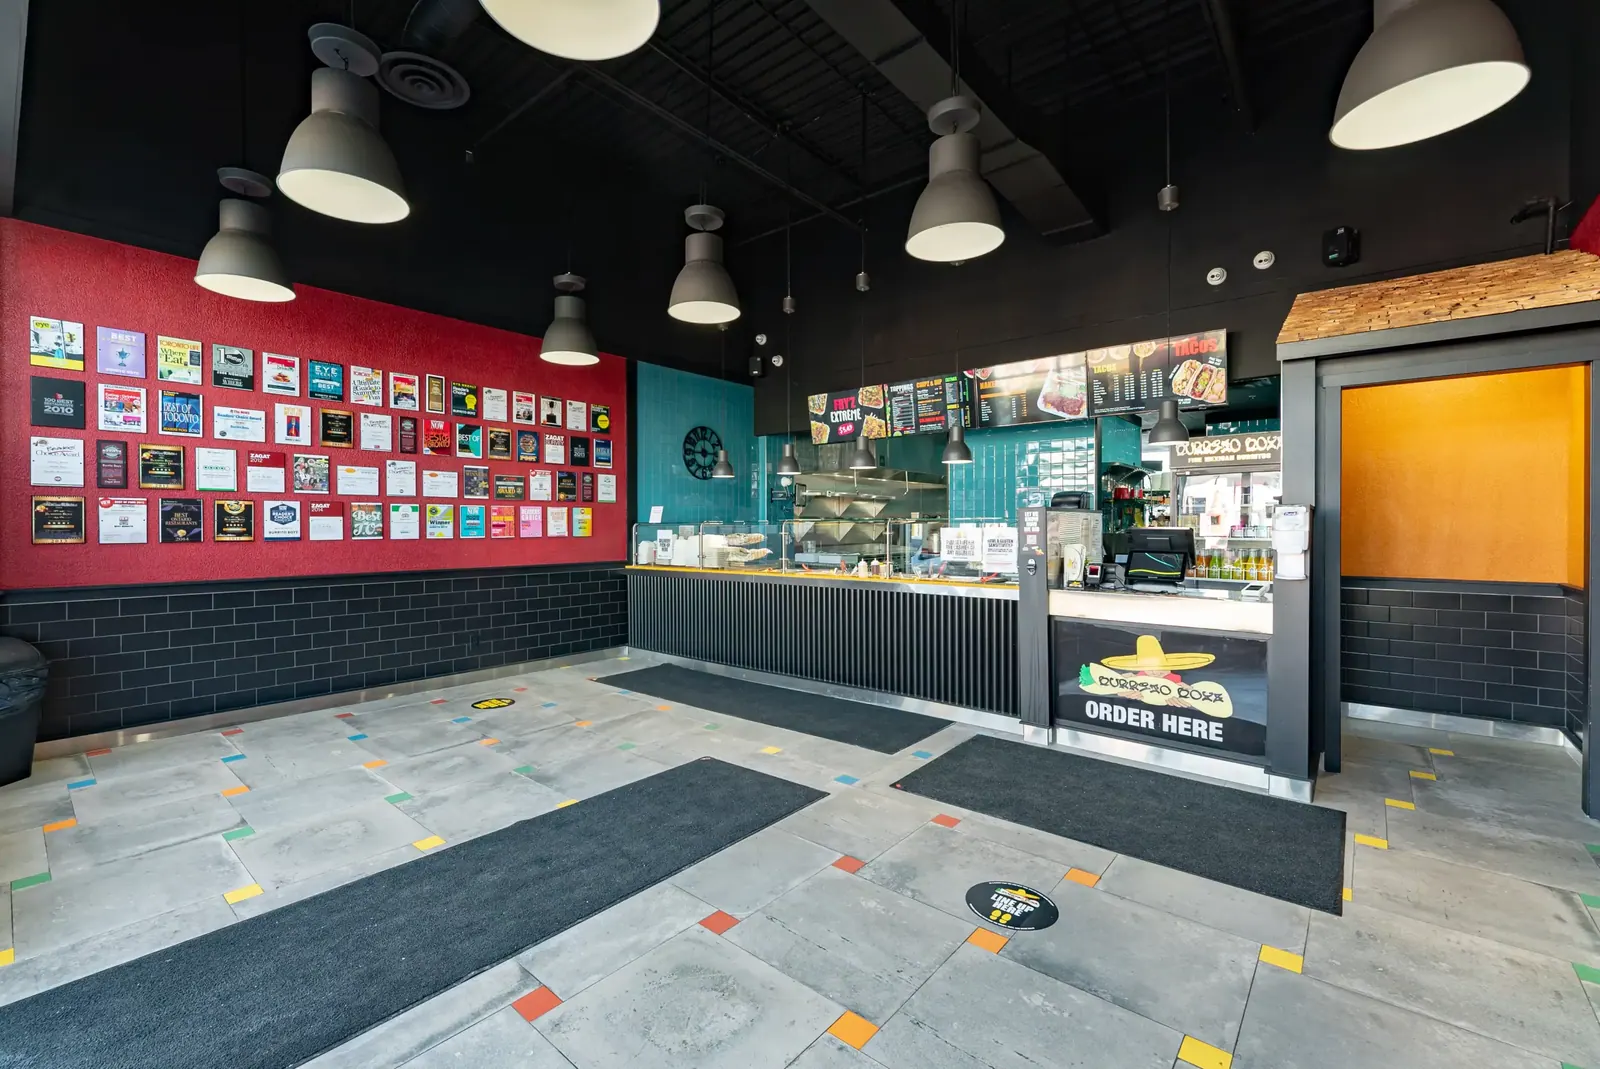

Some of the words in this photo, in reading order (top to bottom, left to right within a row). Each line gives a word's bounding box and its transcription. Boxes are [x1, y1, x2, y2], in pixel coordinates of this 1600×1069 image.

[34, 321, 50, 329] eye
[111, 332, 137, 342] BEST
[159, 347, 186, 358] Where
[1175, 338, 1217, 357] TACOS
[164, 354, 183, 365] Eat
[315, 365, 338, 375] EYE
[1092, 363, 1117, 374] TACOS
[890, 384, 914, 393] TOPPINGS
[44, 406, 74, 414] 2010
[163, 402, 180, 412] BEST
[181, 404, 192, 413] OF
[163, 412, 199, 423] TORONTO
[830, 408, 862, 423] EXTREME
[472, 434, 480, 442] OF
[1098, 675, 1172, 696] BURRITO
[1085, 700, 1155, 730] ORDER
[1162, 713, 1223, 743] HERE
[990, 893, 1017, 907] LINE
[1017, 903, 1034, 913] UP
[992, 901, 1024, 917] HERE
